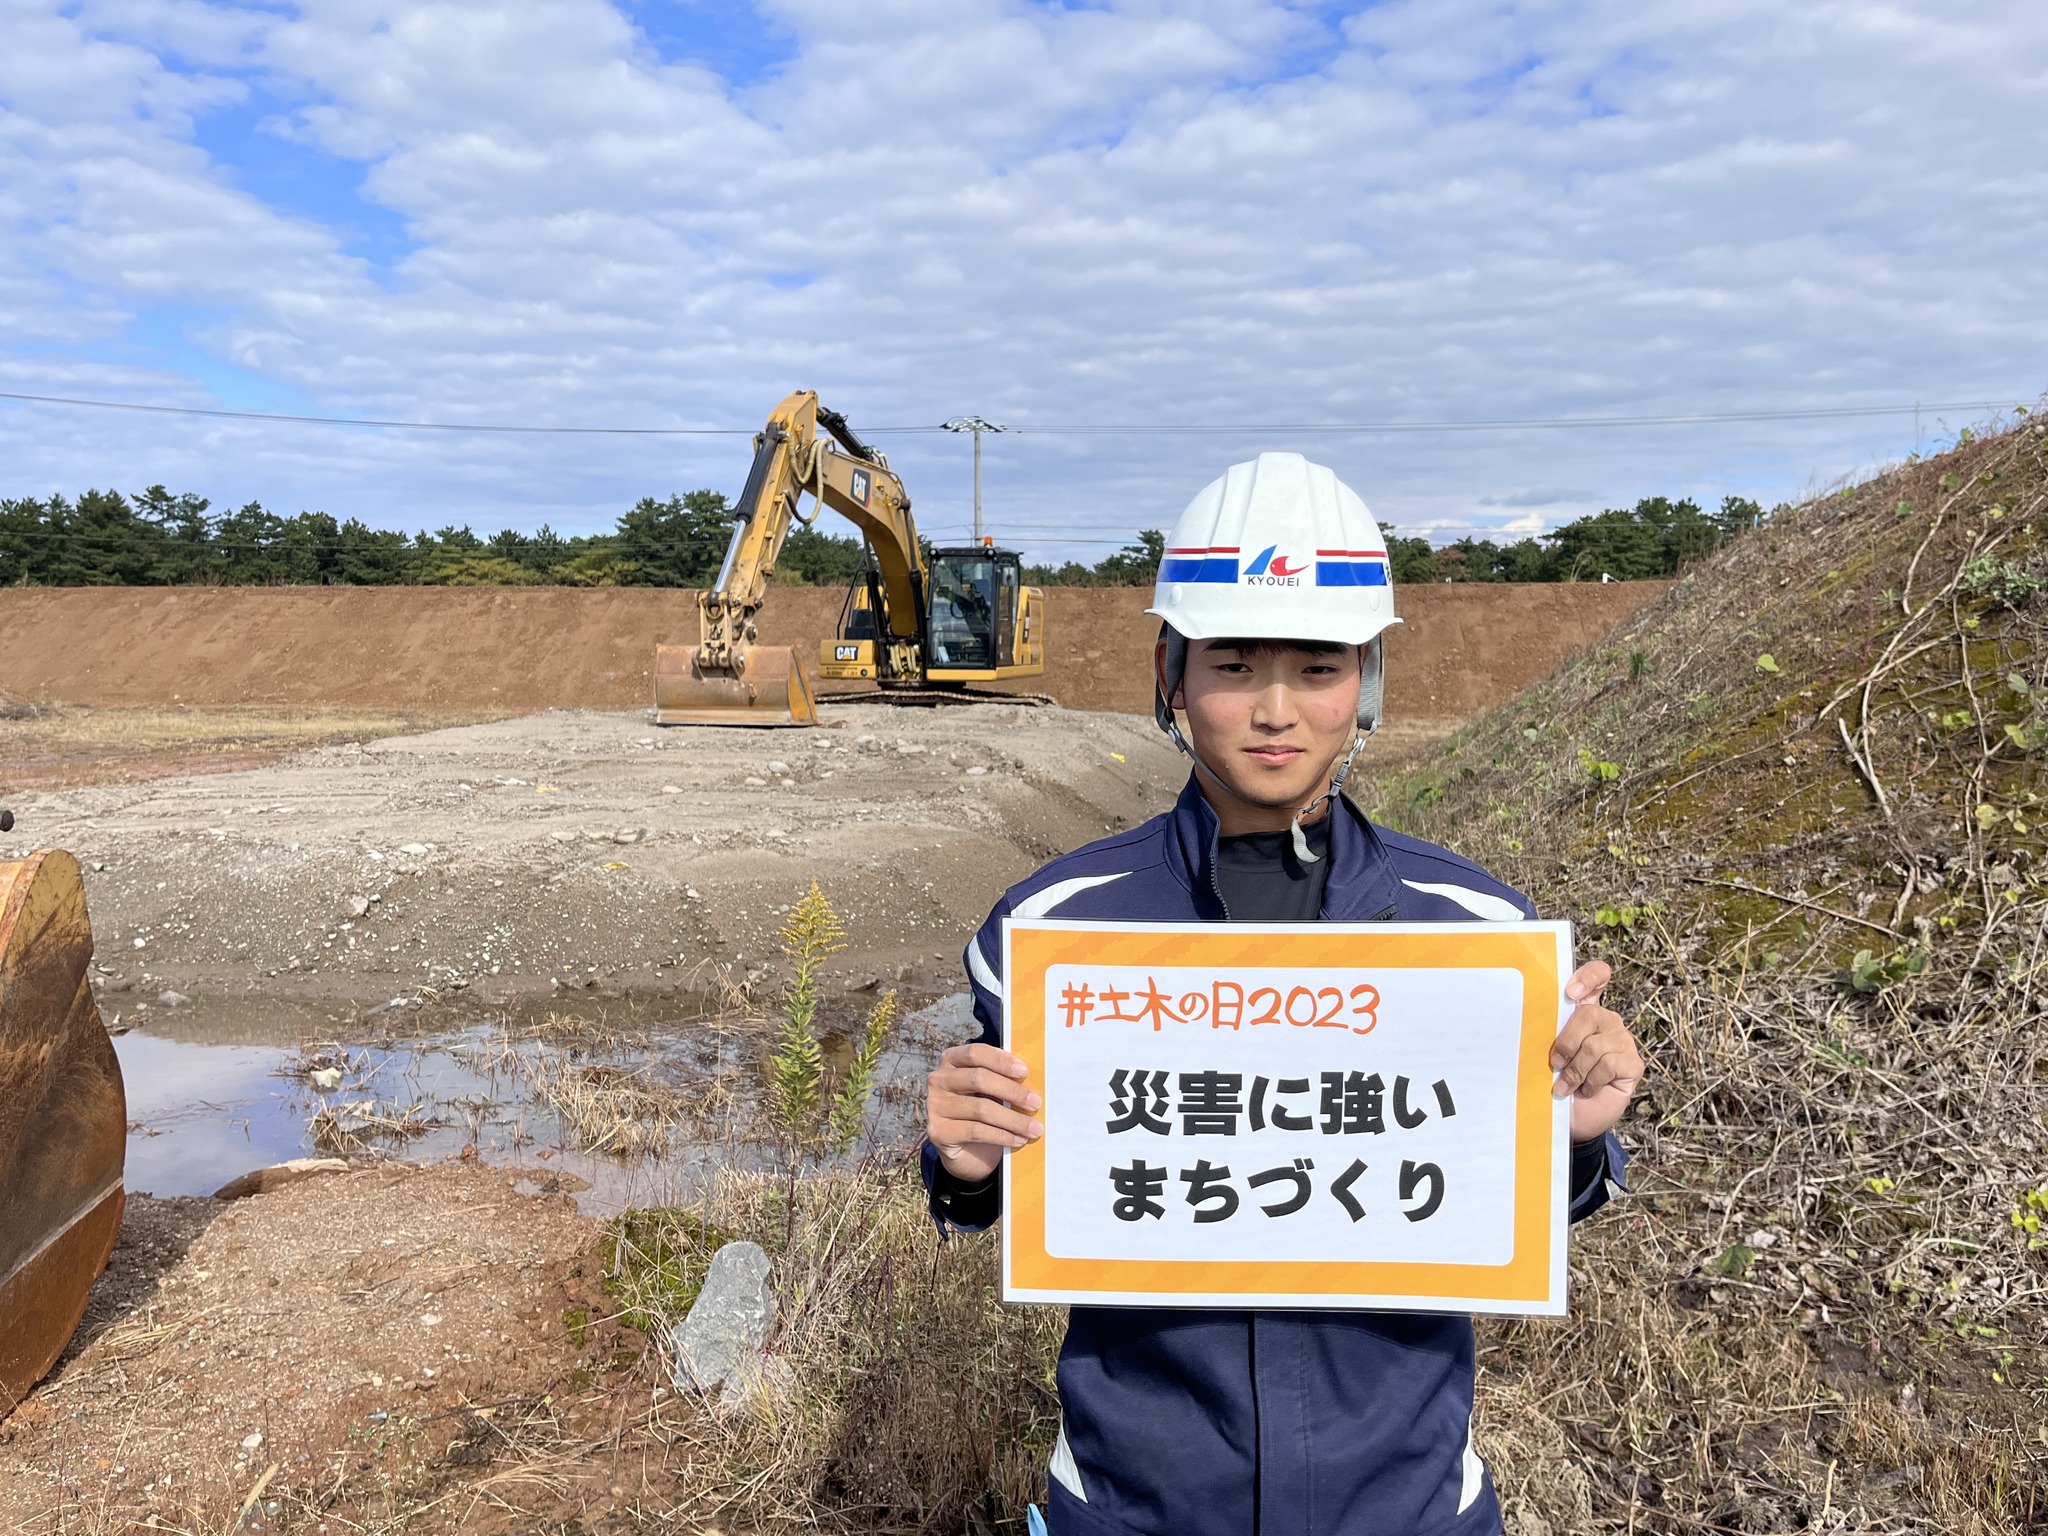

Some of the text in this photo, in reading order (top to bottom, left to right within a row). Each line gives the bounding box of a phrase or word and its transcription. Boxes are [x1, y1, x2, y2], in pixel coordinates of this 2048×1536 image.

[853, 472, 867, 502] CAT
[1247, 576, 1300, 587] KYOUEI
[836, 646, 857, 660] CAT
[1057, 976, 1381, 1035] #土木の日2023
[1105, 1068, 1457, 1136] 災害に強い
[1108, 1157, 1446, 1224] まちづくり
